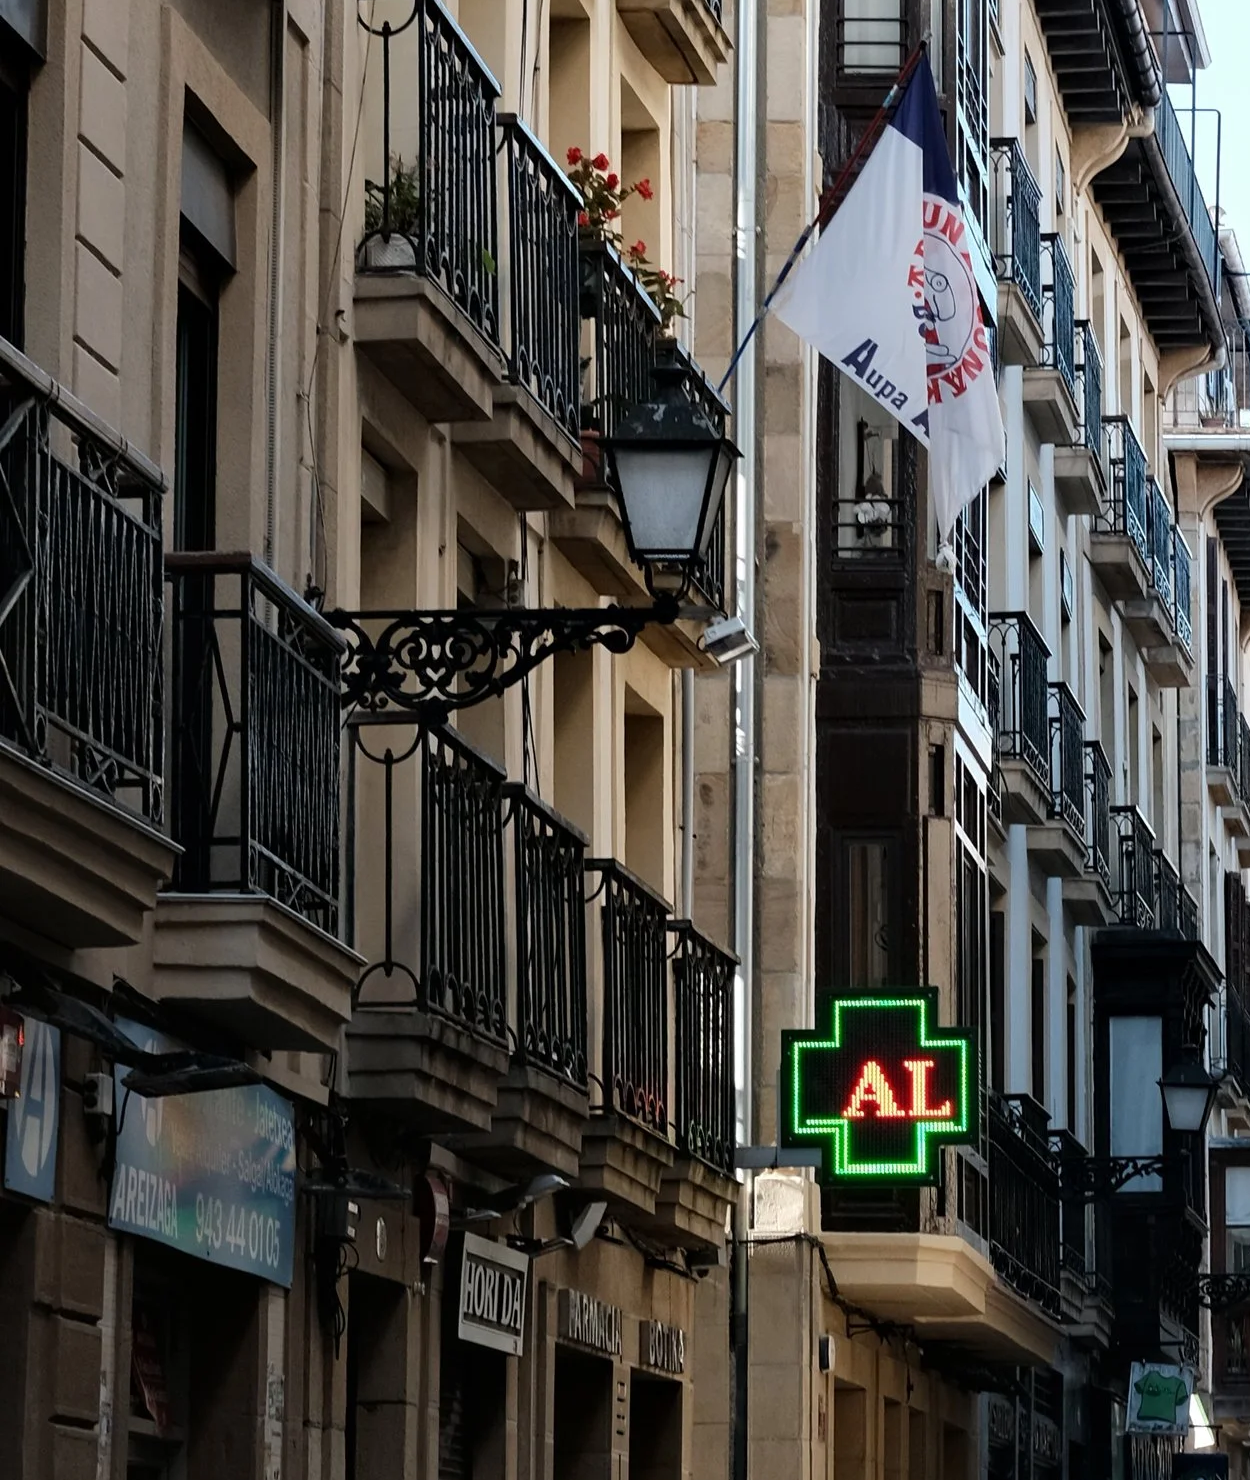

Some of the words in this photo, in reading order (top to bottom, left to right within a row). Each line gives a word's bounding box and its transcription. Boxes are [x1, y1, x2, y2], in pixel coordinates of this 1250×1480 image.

[841, 337, 907, 411] Aupa
[253, 1090, 295, 1152] Jatetxea
[843, 1060, 952, 1117] AL
[111, 1164, 178, 1240] AREIZAGA
[195, 1192, 223, 1249] 943
[225, 1203, 246, 1257] 44
[464, 1260, 500, 1324] HORI
[502, 1271, 522, 1330] DA
[568, 1288, 623, 1356] FARMACIA
